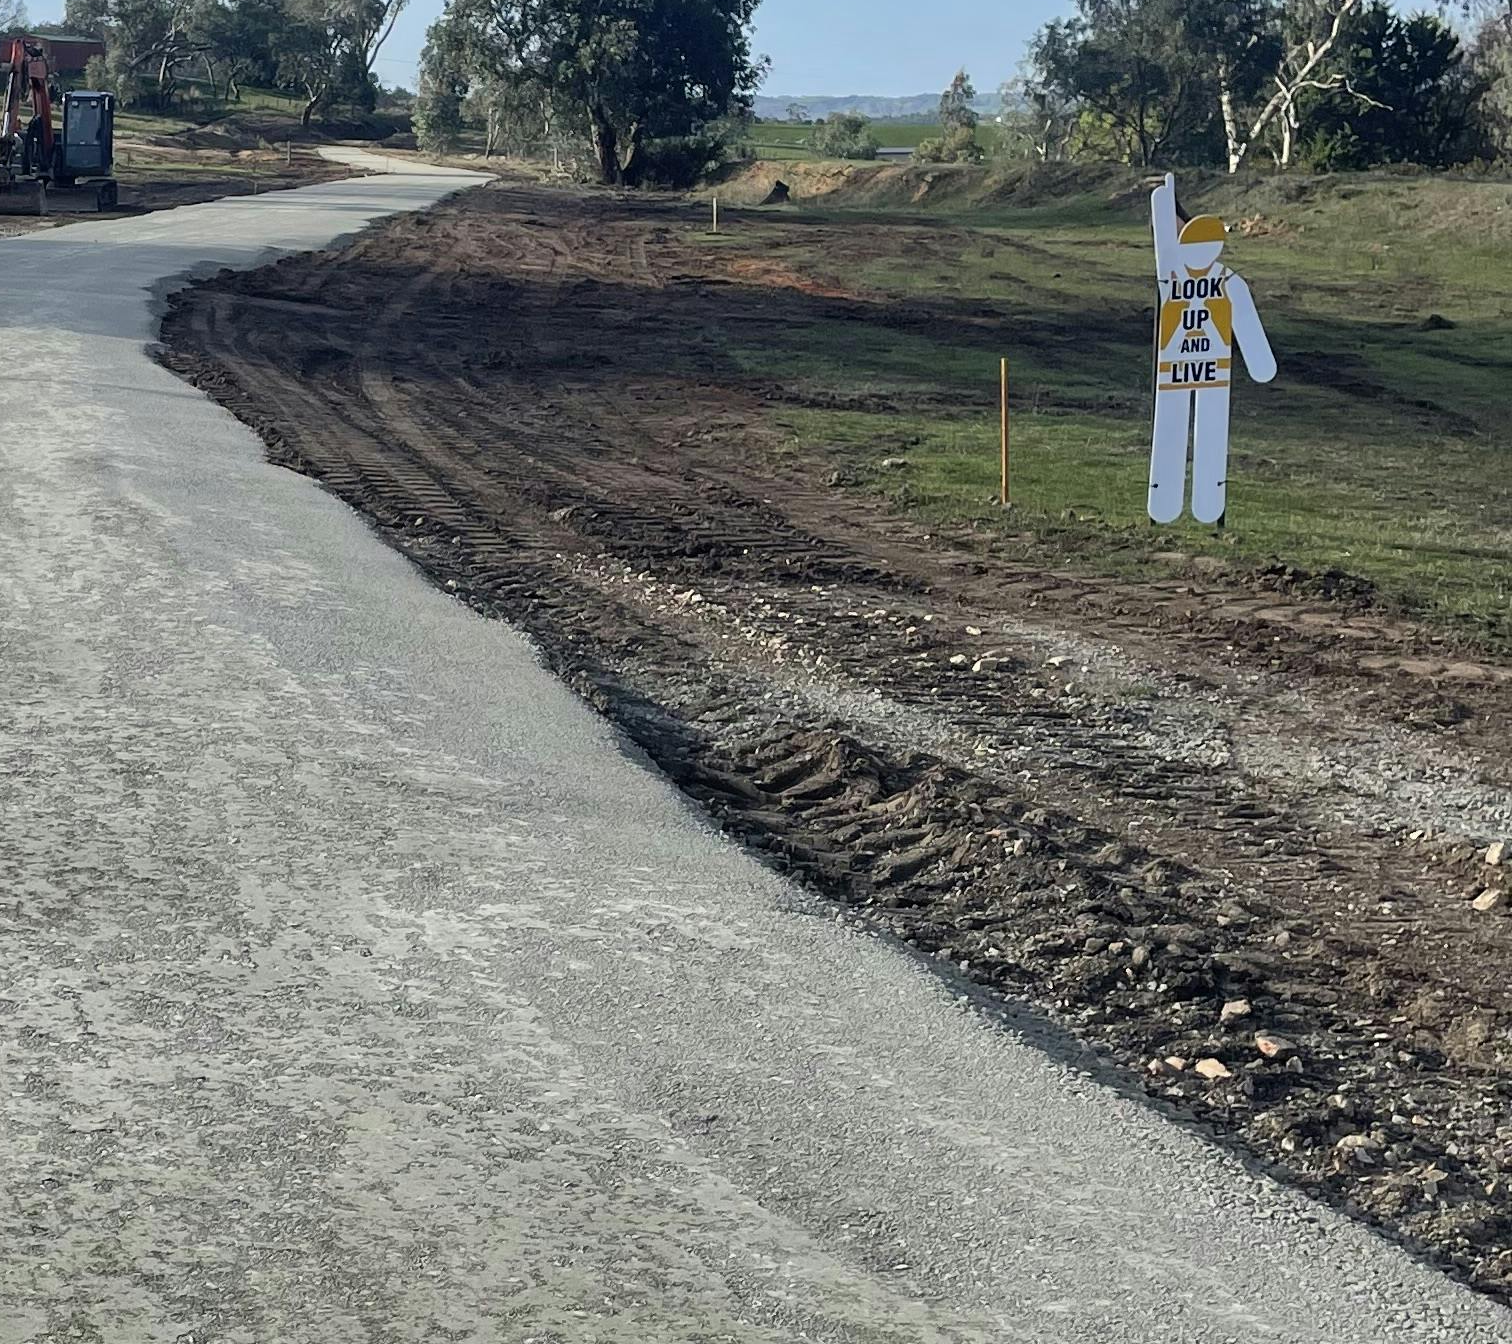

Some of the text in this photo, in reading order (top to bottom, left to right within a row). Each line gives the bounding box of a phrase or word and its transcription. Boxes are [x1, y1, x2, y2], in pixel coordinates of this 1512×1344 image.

[1171, 277, 1223, 300] LOOK
[1182, 309, 1210, 331] UP
[1180, 337, 1210, 354] AND
[1171, 361, 1217, 384] LIVE
